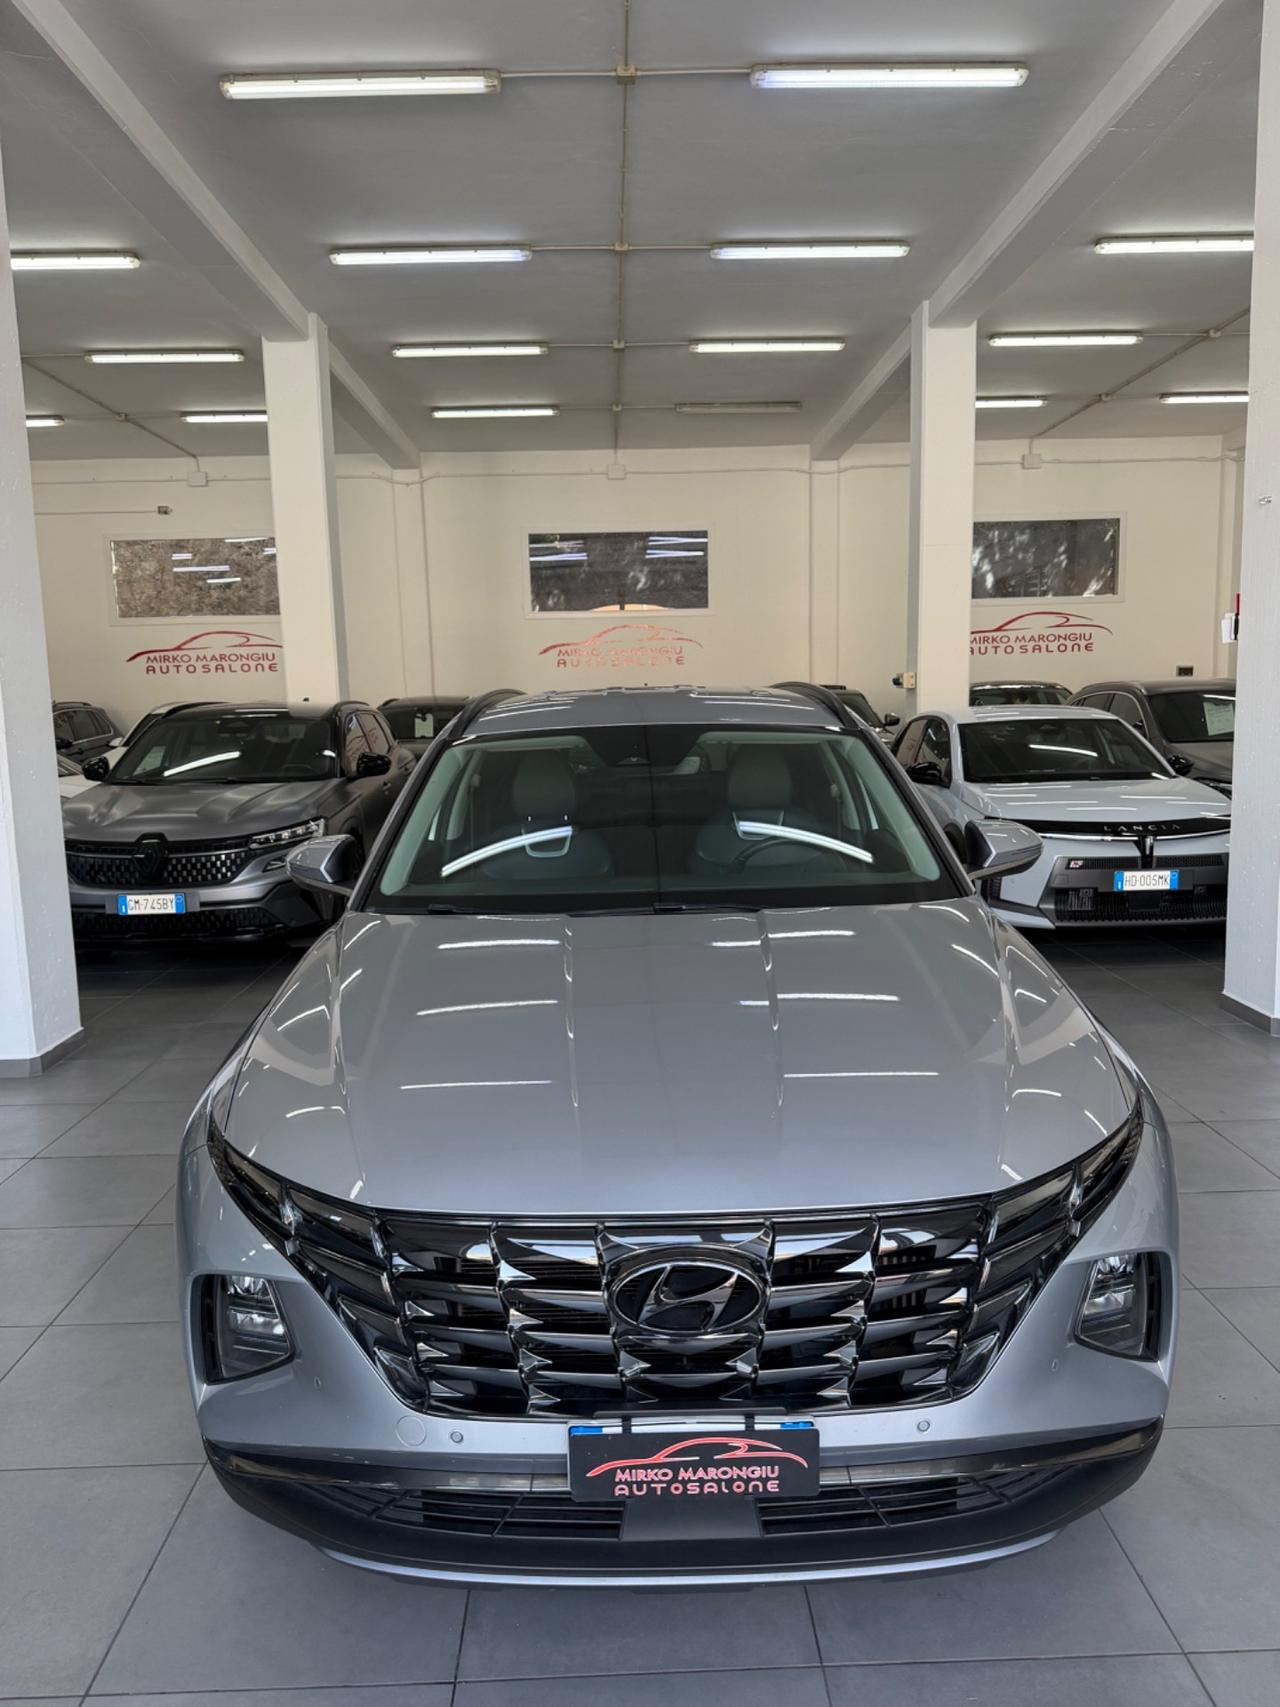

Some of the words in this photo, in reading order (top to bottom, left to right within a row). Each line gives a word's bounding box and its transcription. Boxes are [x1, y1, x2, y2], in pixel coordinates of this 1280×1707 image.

[1014, 632, 1093, 643] MARONGIU
[146, 653, 192, 664] MIRKO
[195, 652, 276, 663] MARONGIU
[145, 663, 279, 675] AUTOSALONE
[1104, 823, 1181, 831] LANCIA
[614, 1468, 674, 1482] MIRKO
[678, 1466, 780, 1481] MARONGIU
[614, 1480, 780, 1497] AUTOSALONE
